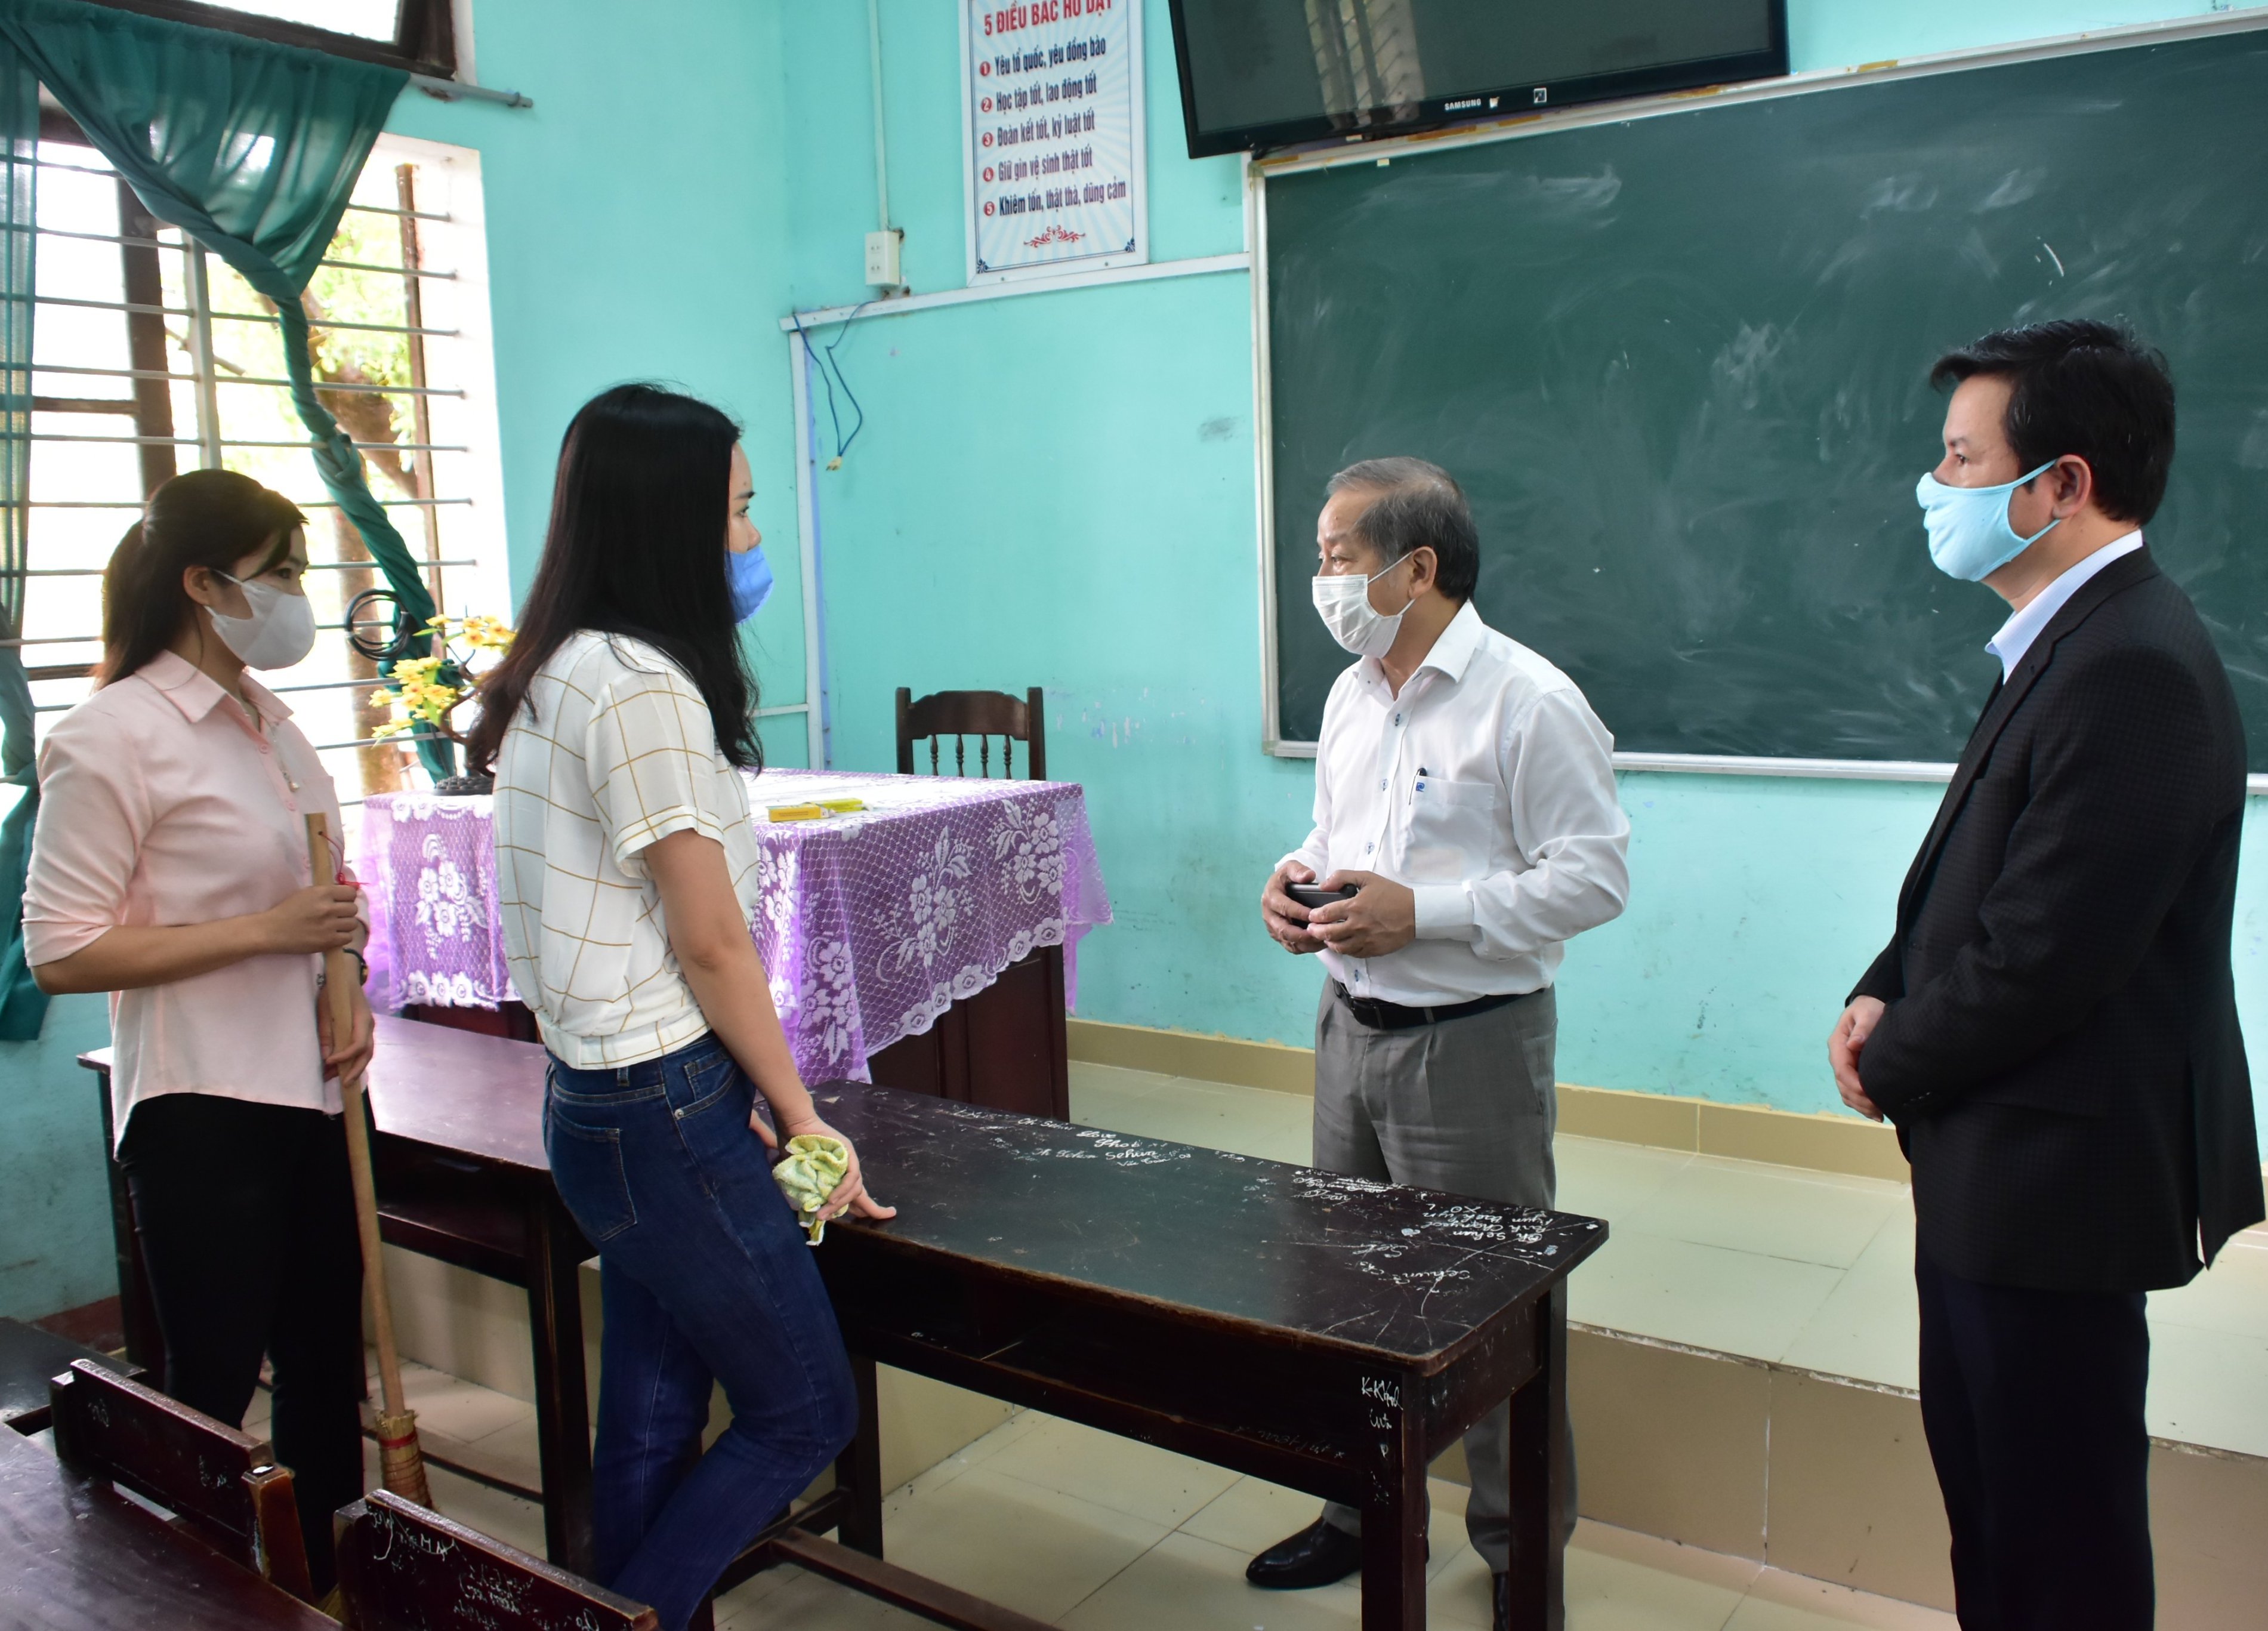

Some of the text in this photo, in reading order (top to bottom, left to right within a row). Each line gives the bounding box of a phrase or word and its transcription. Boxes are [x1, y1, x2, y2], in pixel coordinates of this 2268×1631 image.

[985, 13, 992, 36] 5
[995, 54, 1010, 76] Yêu
[1013, 47, 1020, 72] tổ
[1023, 45, 1046, 72] quốc,
[1048, 43, 1063, 67] yêu
[1090, 34, 1106, 56] bào
[996, 91, 1012, 115] Học
[1014, 87, 1027, 112] tập
[1030, 81, 1043, 105] tốt,
[1046, 82, 1059, 101] lao
[1062, 76, 1082, 103] động
[1085, 69, 1097, 94] tốt
[1445, 98, 1481, 110] SAMSUNG
[998, 124, 1018, 146] Đoàn
[1020, 118, 1033, 142] kết
[1036, 115, 1050, 140] tốt,
[1052, 113, 1062, 138] kỷ
[1064, 112, 1081, 137] luật
[1084, 106, 1095, 131] tốt
[998, 160, 1012, 181] Giữ
[1014, 158, 1027, 181] gìn
[1029, 155, 1039, 180] vệ
[1042, 152, 1059, 174] sinh
[1062, 149, 1078, 174] thật
[1081, 143, 1093, 168] tốt
[999, 193, 1025, 215] Khiêm
[1028, 188, 1044, 212] tốn,
[1046, 187, 1063, 212] thật
[1064, 185, 1081, 206] thà,
[1083, 182, 1104, 203] dũng
[1107, 175, 1126, 199] cảm
